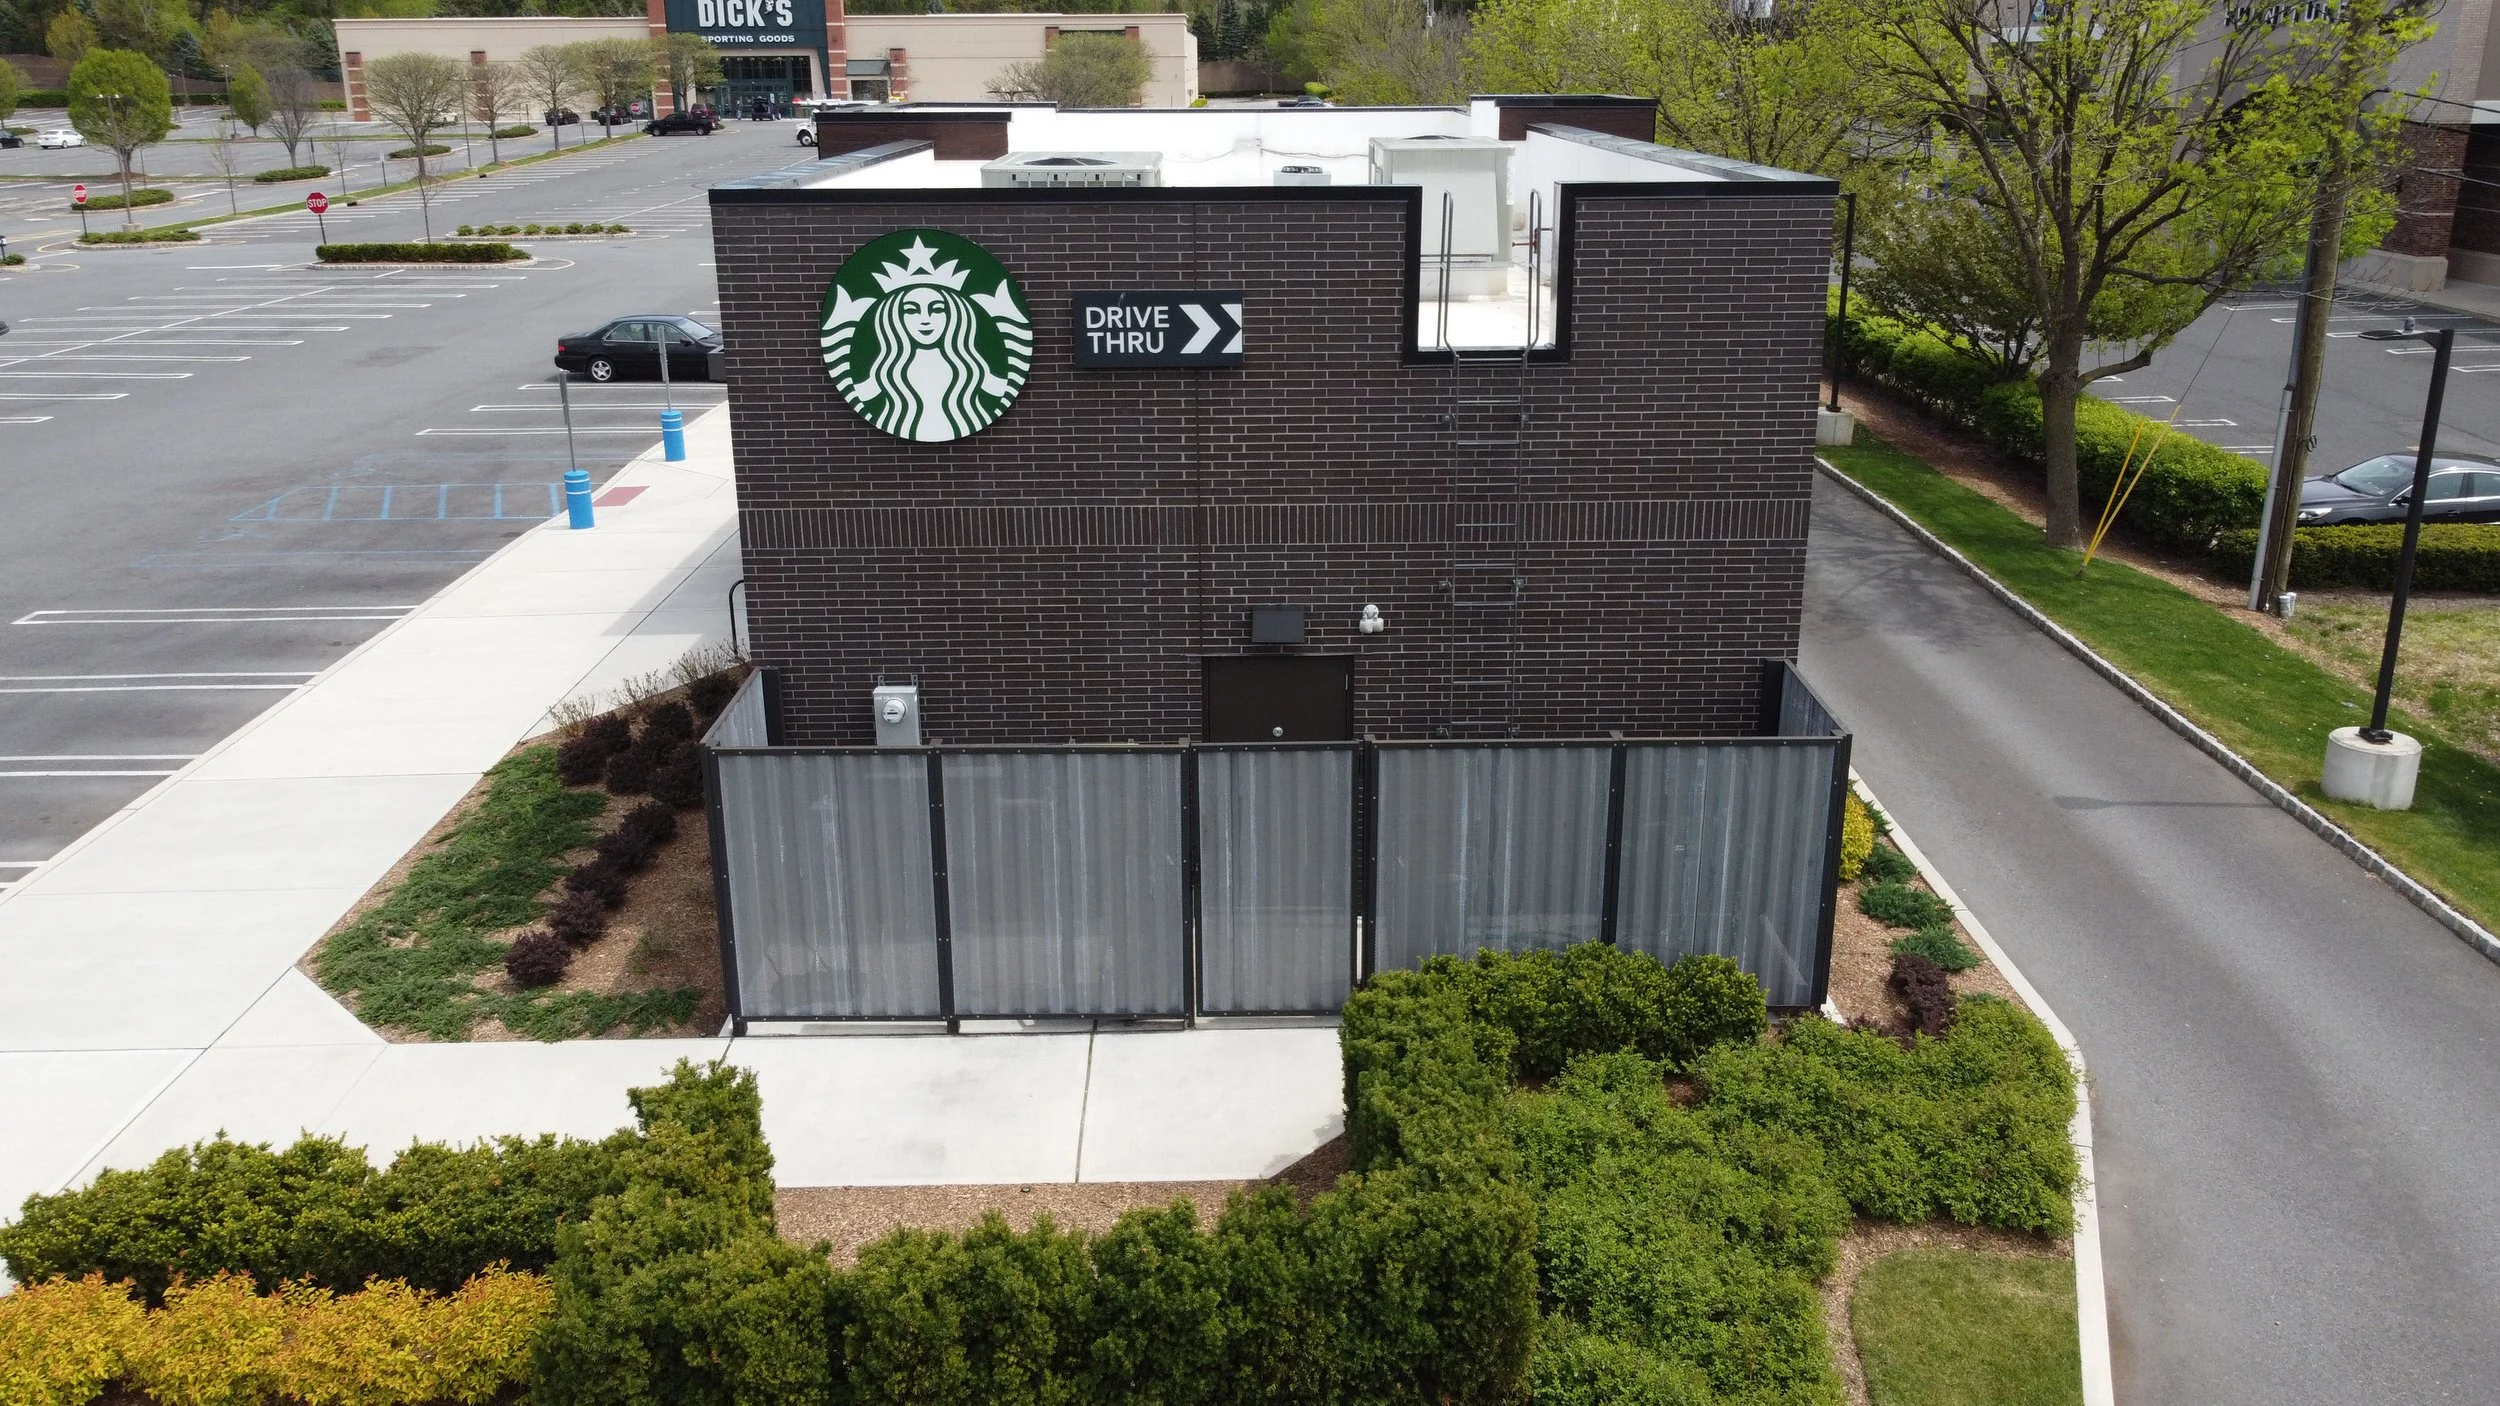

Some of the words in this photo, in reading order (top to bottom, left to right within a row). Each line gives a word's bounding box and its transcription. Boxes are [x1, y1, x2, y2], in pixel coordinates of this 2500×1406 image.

[698, 0, 793, 27] DICK'S
[701, 35, 754, 43] SPORTING
[308, 199, 326, 208] STOP
[1086, 306, 1170, 329] DRIVE
[1086, 331, 1164, 354] THRU
